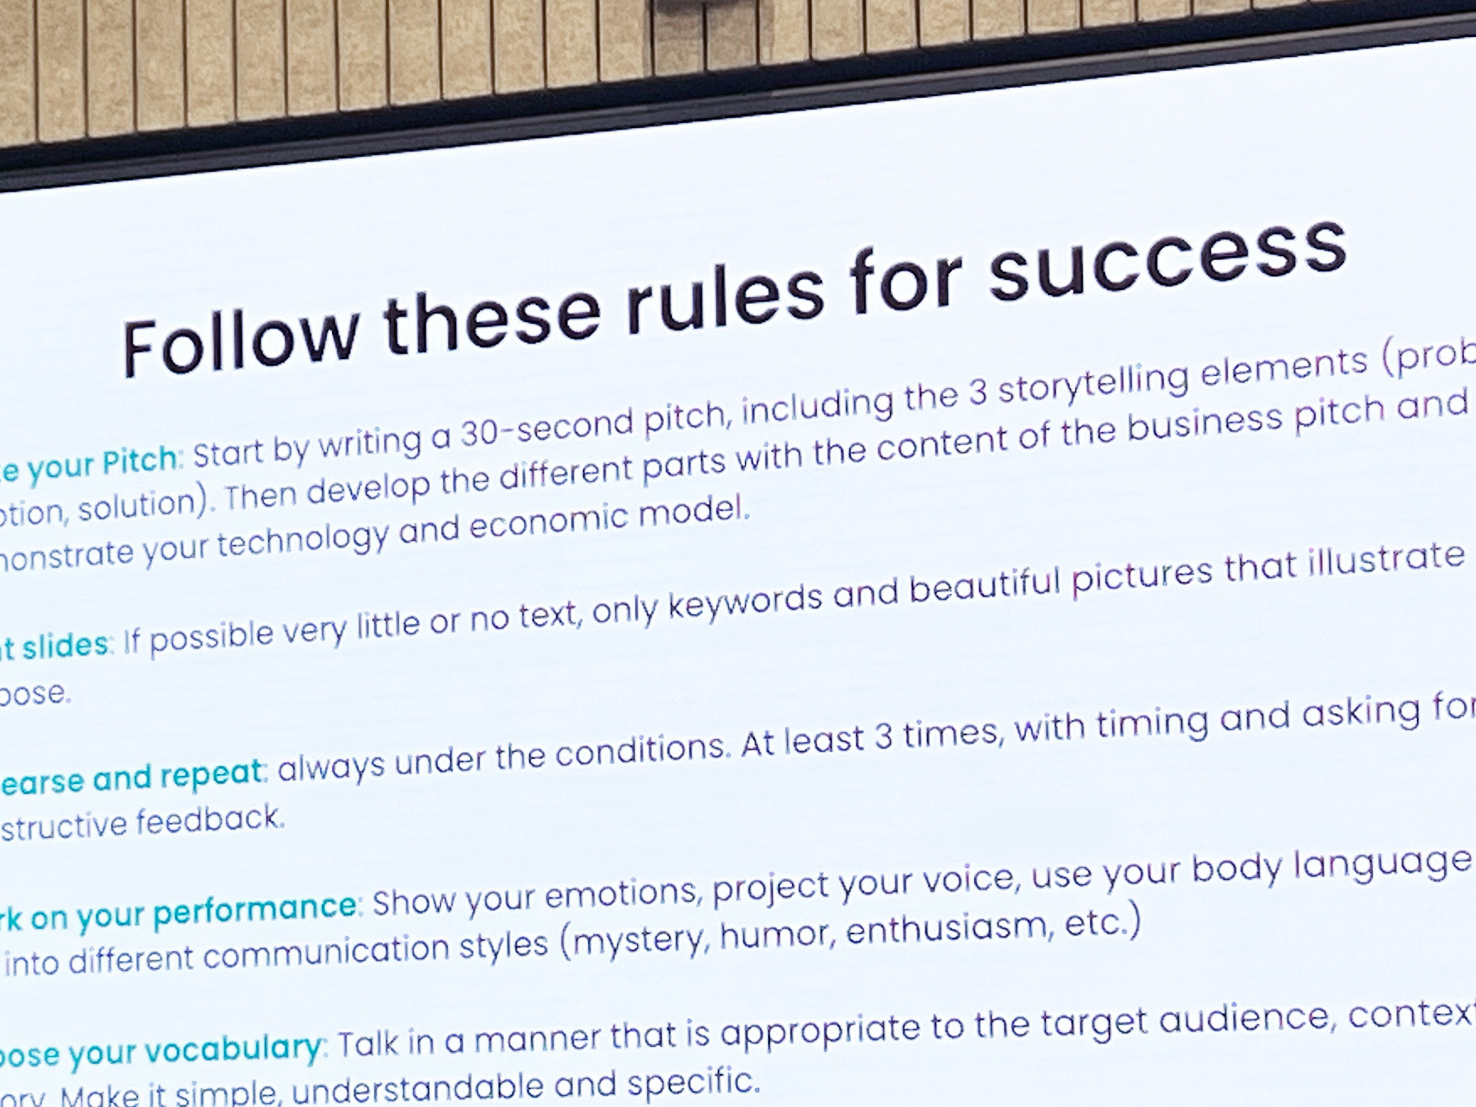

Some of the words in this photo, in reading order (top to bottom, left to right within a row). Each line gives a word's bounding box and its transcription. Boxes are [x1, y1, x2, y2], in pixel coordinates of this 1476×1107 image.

[125, 308, 361, 379] Follow
[382, 291, 601, 355] these
[628, 263, 824, 335] rules
[849, 245, 963, 315] for
[990, 221, 1346, 302] success
[27, 457, 95, 489] your
[103, 445, 183, 475] Pitch:
[194, 439, 264, 468] Start
[274, 436, 310, 469] by
[318, 427, 421, 460] writing
[432, 428, 450, 449] a
[461, 407, 633, 446] 30-second
[645, 400, 732, 441] pitch,
[743, 388, 893, 424] including
[904, 383, 958, 410] the
[970, 378, 987, 405] 3
[999, 363, 1188, 407] storytelling
[1201, 349, 1367, 386] elements
[79, 480, 215, 521] solution).
[225, 484, 296, 510] Then
[307, 472, 430, 506] develop
[440, 467, 489, 494] the
[500, 456, 633, 489] different
[643, 449, 726, 488] parts
[735, 441, 802, 471] with
[812, 437, 866, 465] the
[877, 426, 1008, 461] content
[1019, 420, 1050, 449] of
[1061, 418, 1116, 446] the
[1128, 407, 1282, 441] business
[1296, 394, 1384, 437] pitch
[1398, 386, 1468, 419] and
[142, 538, 209, 571] your
[217, 523, 389, 557] technology
[399, 514, 459, 544] and
[470, 502, 628, 538] economic
[640, 493, 750, 527] model.
[23, 632, 114, 660] slides:
[125, 627, 140, 654] If
[151, 620, 273, 661] possible
[283, 620, 347, 649] very
[358, 611, 420, 639] little
[430, 613, 461, 634] or
[472, 610, 509, 632] no
[519, 601, 583, 630] text,
[593, 594, 658, 629] only
[669, 583, 822, 625] keywords
[834, 577, 898, 607] and
[910, 566, 1060, 603] beautiful
[1073, 562, 1212, 602] pictures
[1225, 552, 1297, 582] that
[1309, 542, 1465, 576] illustrate
[93, 763, 152, 791] and
[161, 758, 268, 795] repeat:
[278, 754, 385, 786] always
[396, 746, 486, 775] under
[496, 742, 545, 770] the
[556, 734, 731, 766] conditions.
[741, 730, 775, 757] At
[785, 726, 864, 754] least
[876, 722, 892, 749] 3
[903, 720, 1004, 749] times,
[1014, 712, 1085, 742] with
[1096, 707, 1208, 742] timing
[1221, 700, 1289, 731] and
[1303, 695, 1419, 731] asking
[136, 802, 284, 835] feedback.
[5, 950, 59, 976] into
[69, 946, 194, 974] different
[204, 934, 449, 969] communication
[460, 930, 548, 966] styles
[561, 921, 710, 963] (mystery,
[721, 922, 836, 950] humor,
[846, 912, 1054, 944] enthusiasm,
[1066, 899, 1140, 941] etc.)
[31, 909, 68, 930] on
[76, 906, 145, 938] your
[153, 896, 363, 934] performance:
[374, 889, 456, 916] Show
[465, 889, 536, 921] your
[546, 877, 703, 908] emotions,
[714, 872, 829, 911] project
[838, 873, 913, 906] your
[923, 863, 1021, 895] voice,
[1033, 866, 1092, 889] use
[1102, 862, 1181, 895] your
[1193, 852, 1282, 889] body
[1295, 850, 1472, 885] language
[68, 1044, 137, 1075] your
[144, 1033, 328, 1068] vocabulary:
[337, 1029, 399, 1057] Talk
[409, 1027, 434, 1055] in
[445, 1033, 464, 1054] a
[475, 1029, 601, 1053] manner
[610, 1022, 676, 1049] that
[687, 1018, 710, 1047] is
[721, 1014, 920, 1054] appropriate
[931, 1014, 964, 1039] to
[974, 1010, 1030, 1038] the
[1041, 1007, 1148, 1044] target
[1160, 1002, 1336, 1034] audience,
[1349, 1000, 1476, 1028] contex
[293, 1072, 544, 1105] understandable
[555, 1069, 616, 1098] and
[628, 1065, 760, 1104] specific.
